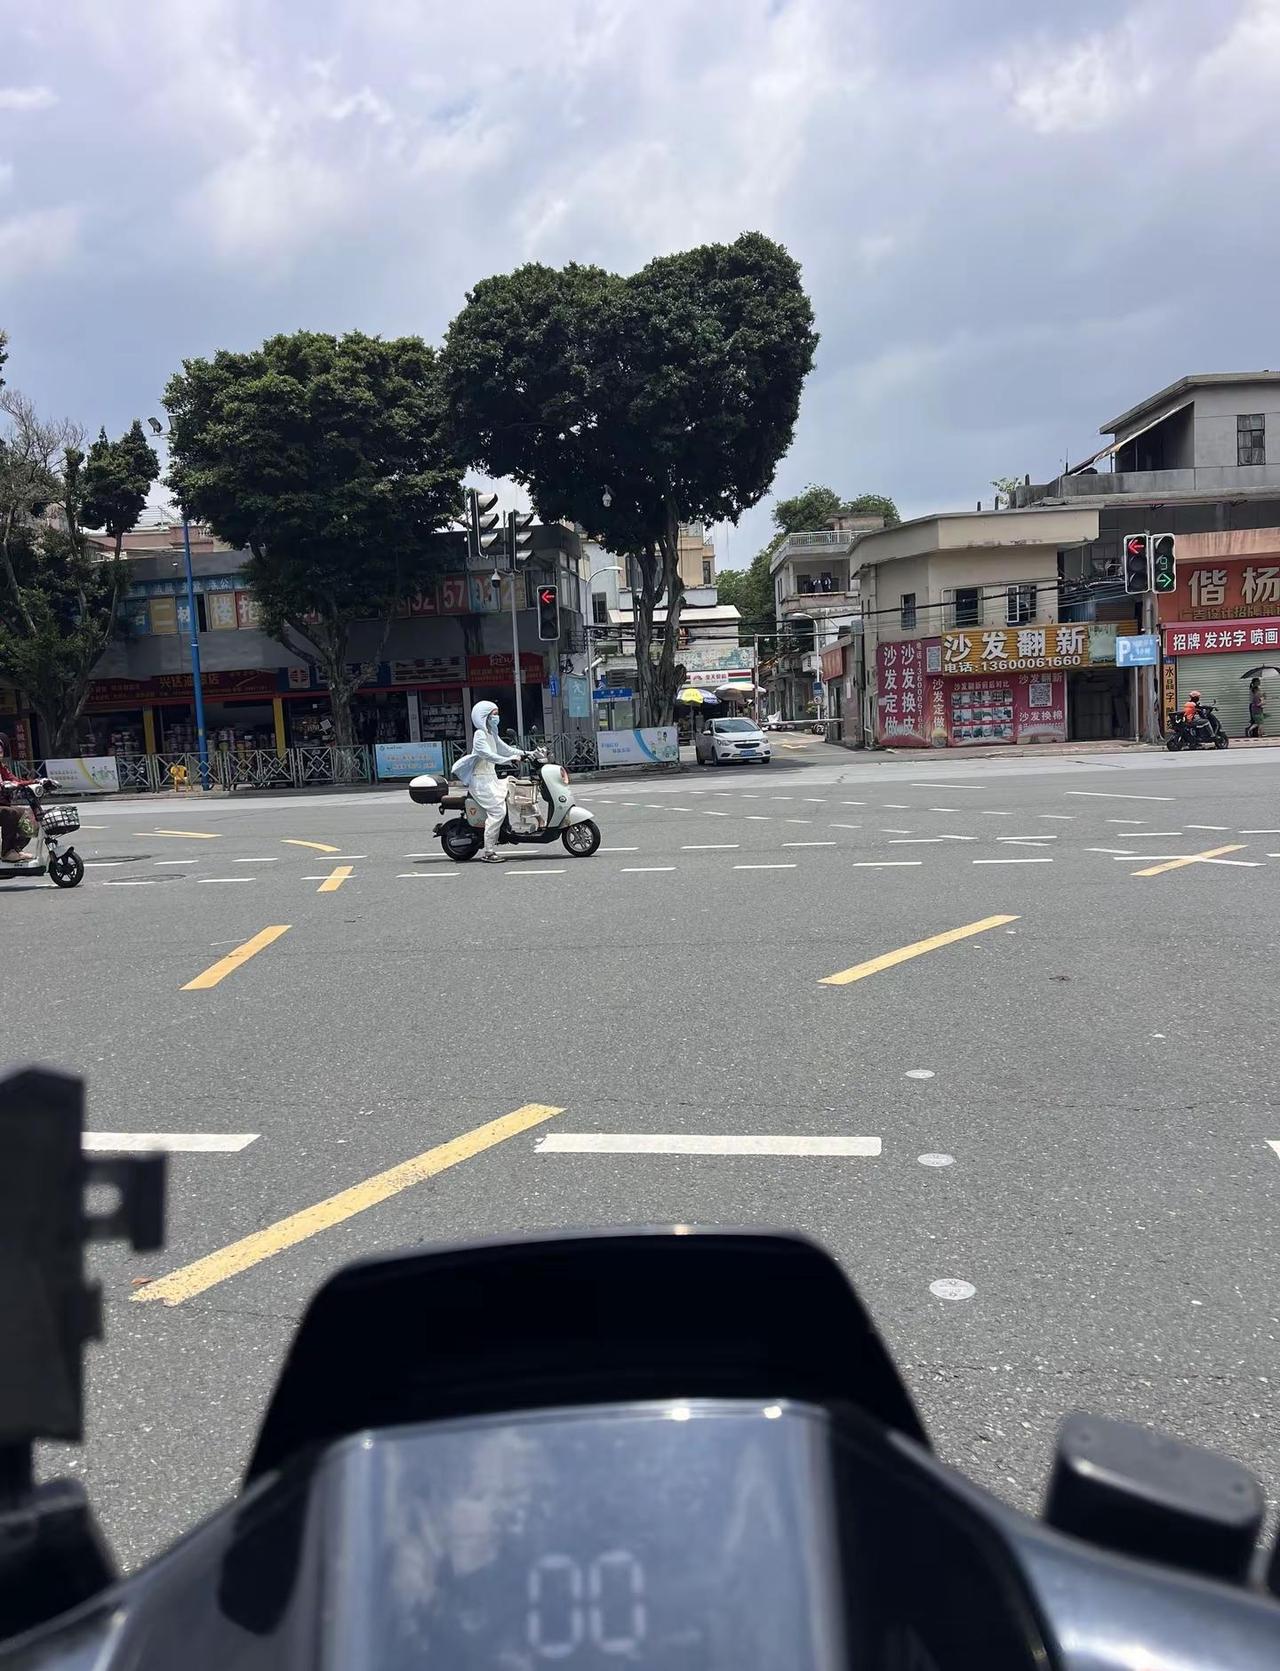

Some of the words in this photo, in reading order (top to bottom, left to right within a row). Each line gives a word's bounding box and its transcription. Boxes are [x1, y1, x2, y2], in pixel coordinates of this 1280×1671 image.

[943, 626, 1086, 662] 沙发翻新
[1173, 633, 1200, 651] 招牌
[1204, 630, 1246, 649] 发光字
[1250, 628, 1278, 646] 喷画
[883, 645, 898, 736] 沙发定做
[901, 643, 916, 736] 沙发换皮
[932, 679, 945, 729] 沙发定做
[528, 1551, 646, 1659] 00
